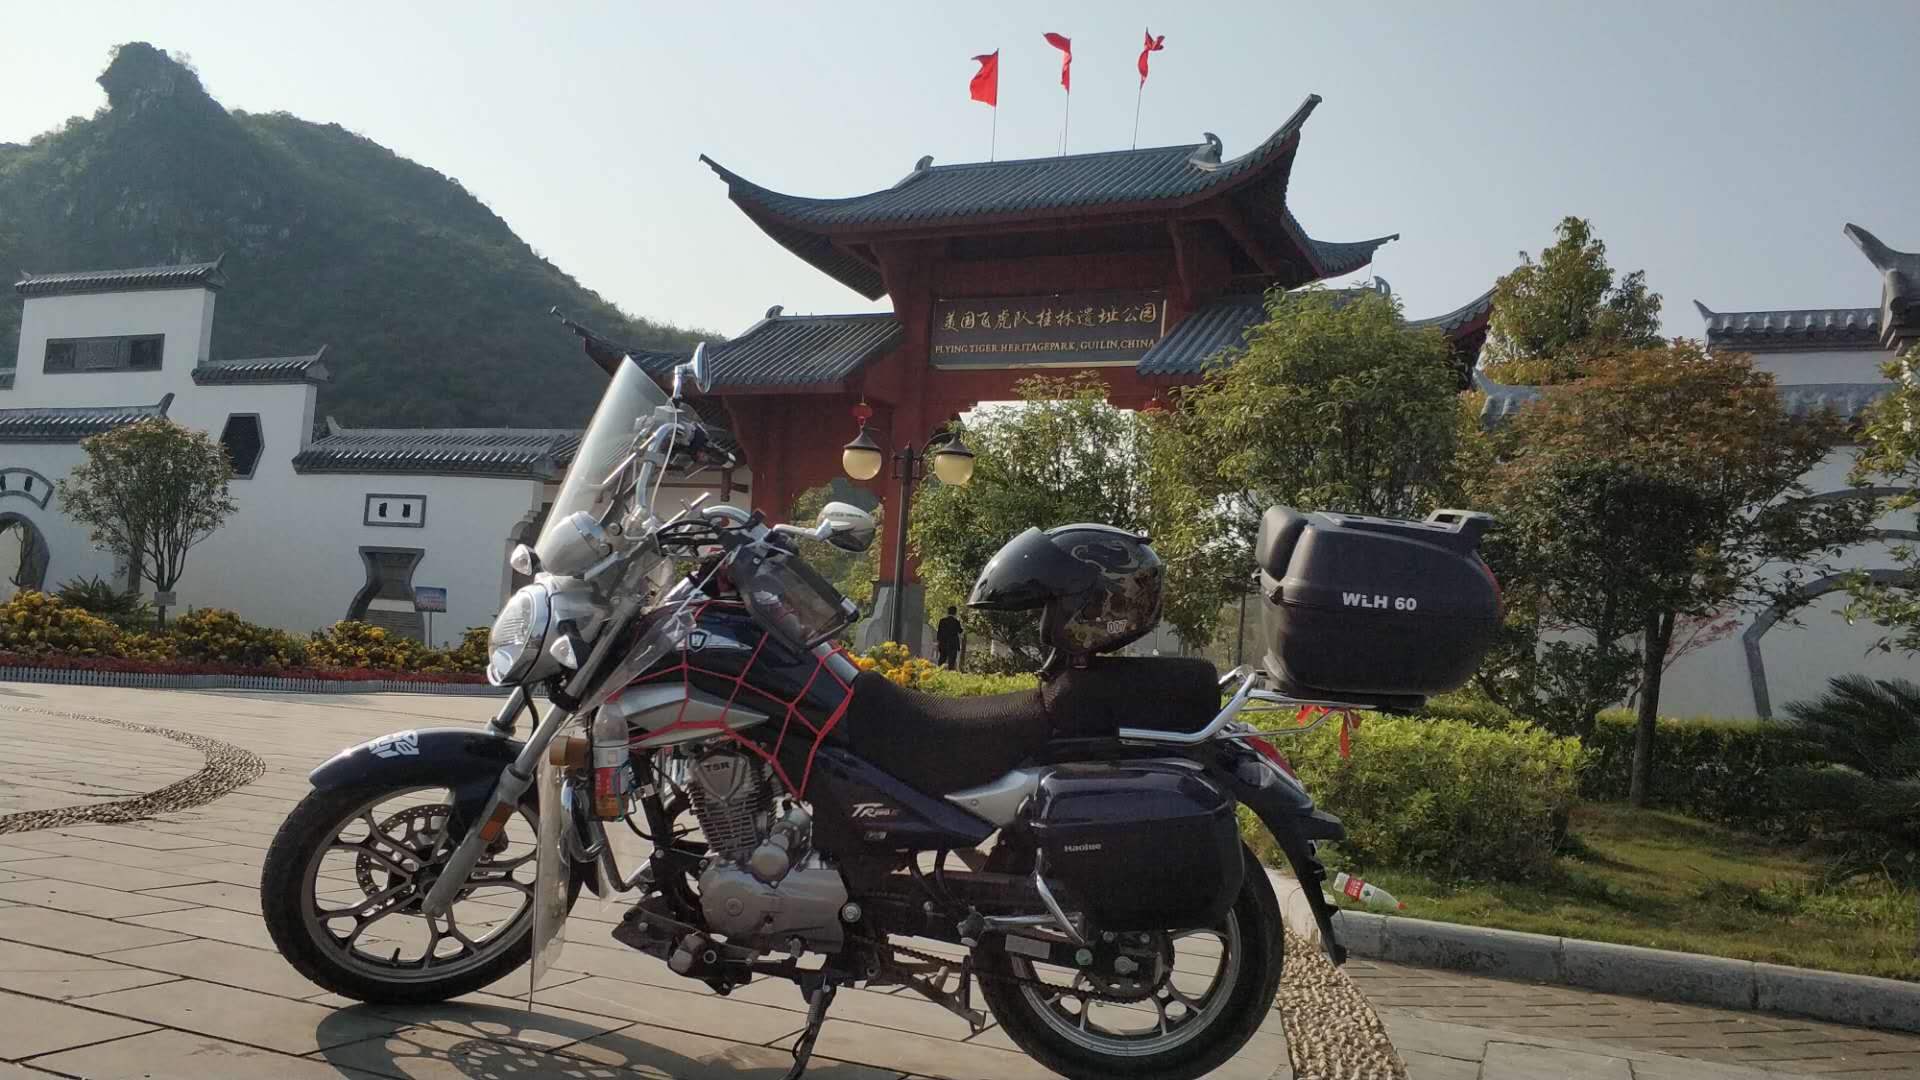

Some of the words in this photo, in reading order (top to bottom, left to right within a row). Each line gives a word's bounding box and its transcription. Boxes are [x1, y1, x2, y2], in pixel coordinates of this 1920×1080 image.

[935, 345, 968, 353] FLYING
[969, 344, 997, 353] TIGER
[1394, 596, 1417, 611] 60
